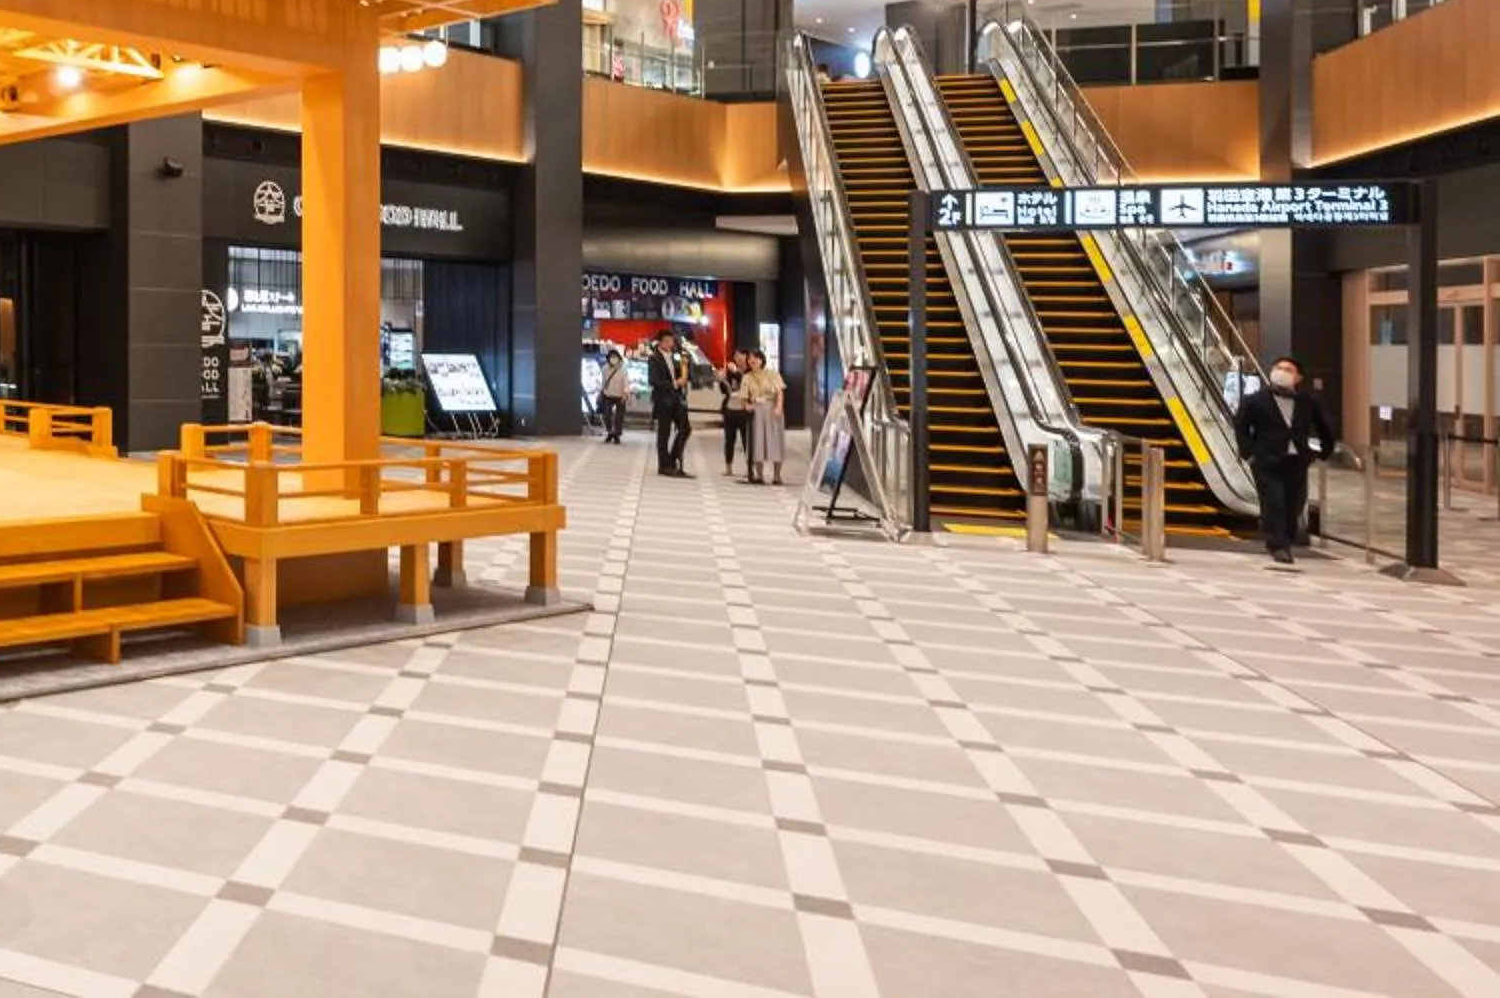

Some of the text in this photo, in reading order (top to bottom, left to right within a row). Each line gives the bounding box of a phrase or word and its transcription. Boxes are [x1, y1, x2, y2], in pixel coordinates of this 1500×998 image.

[1017, 205, 1058, 217] Hotel
[1207, 201, 1259, 213] Haneda
[1261, 200, 1312, 215] Airport
[1315, 199, 1377, 212] Terminal
[938, 207, 962, 226] 2F
[631, 277, 669, 295] FOOD
[679, 282, 714, 299] HALL
